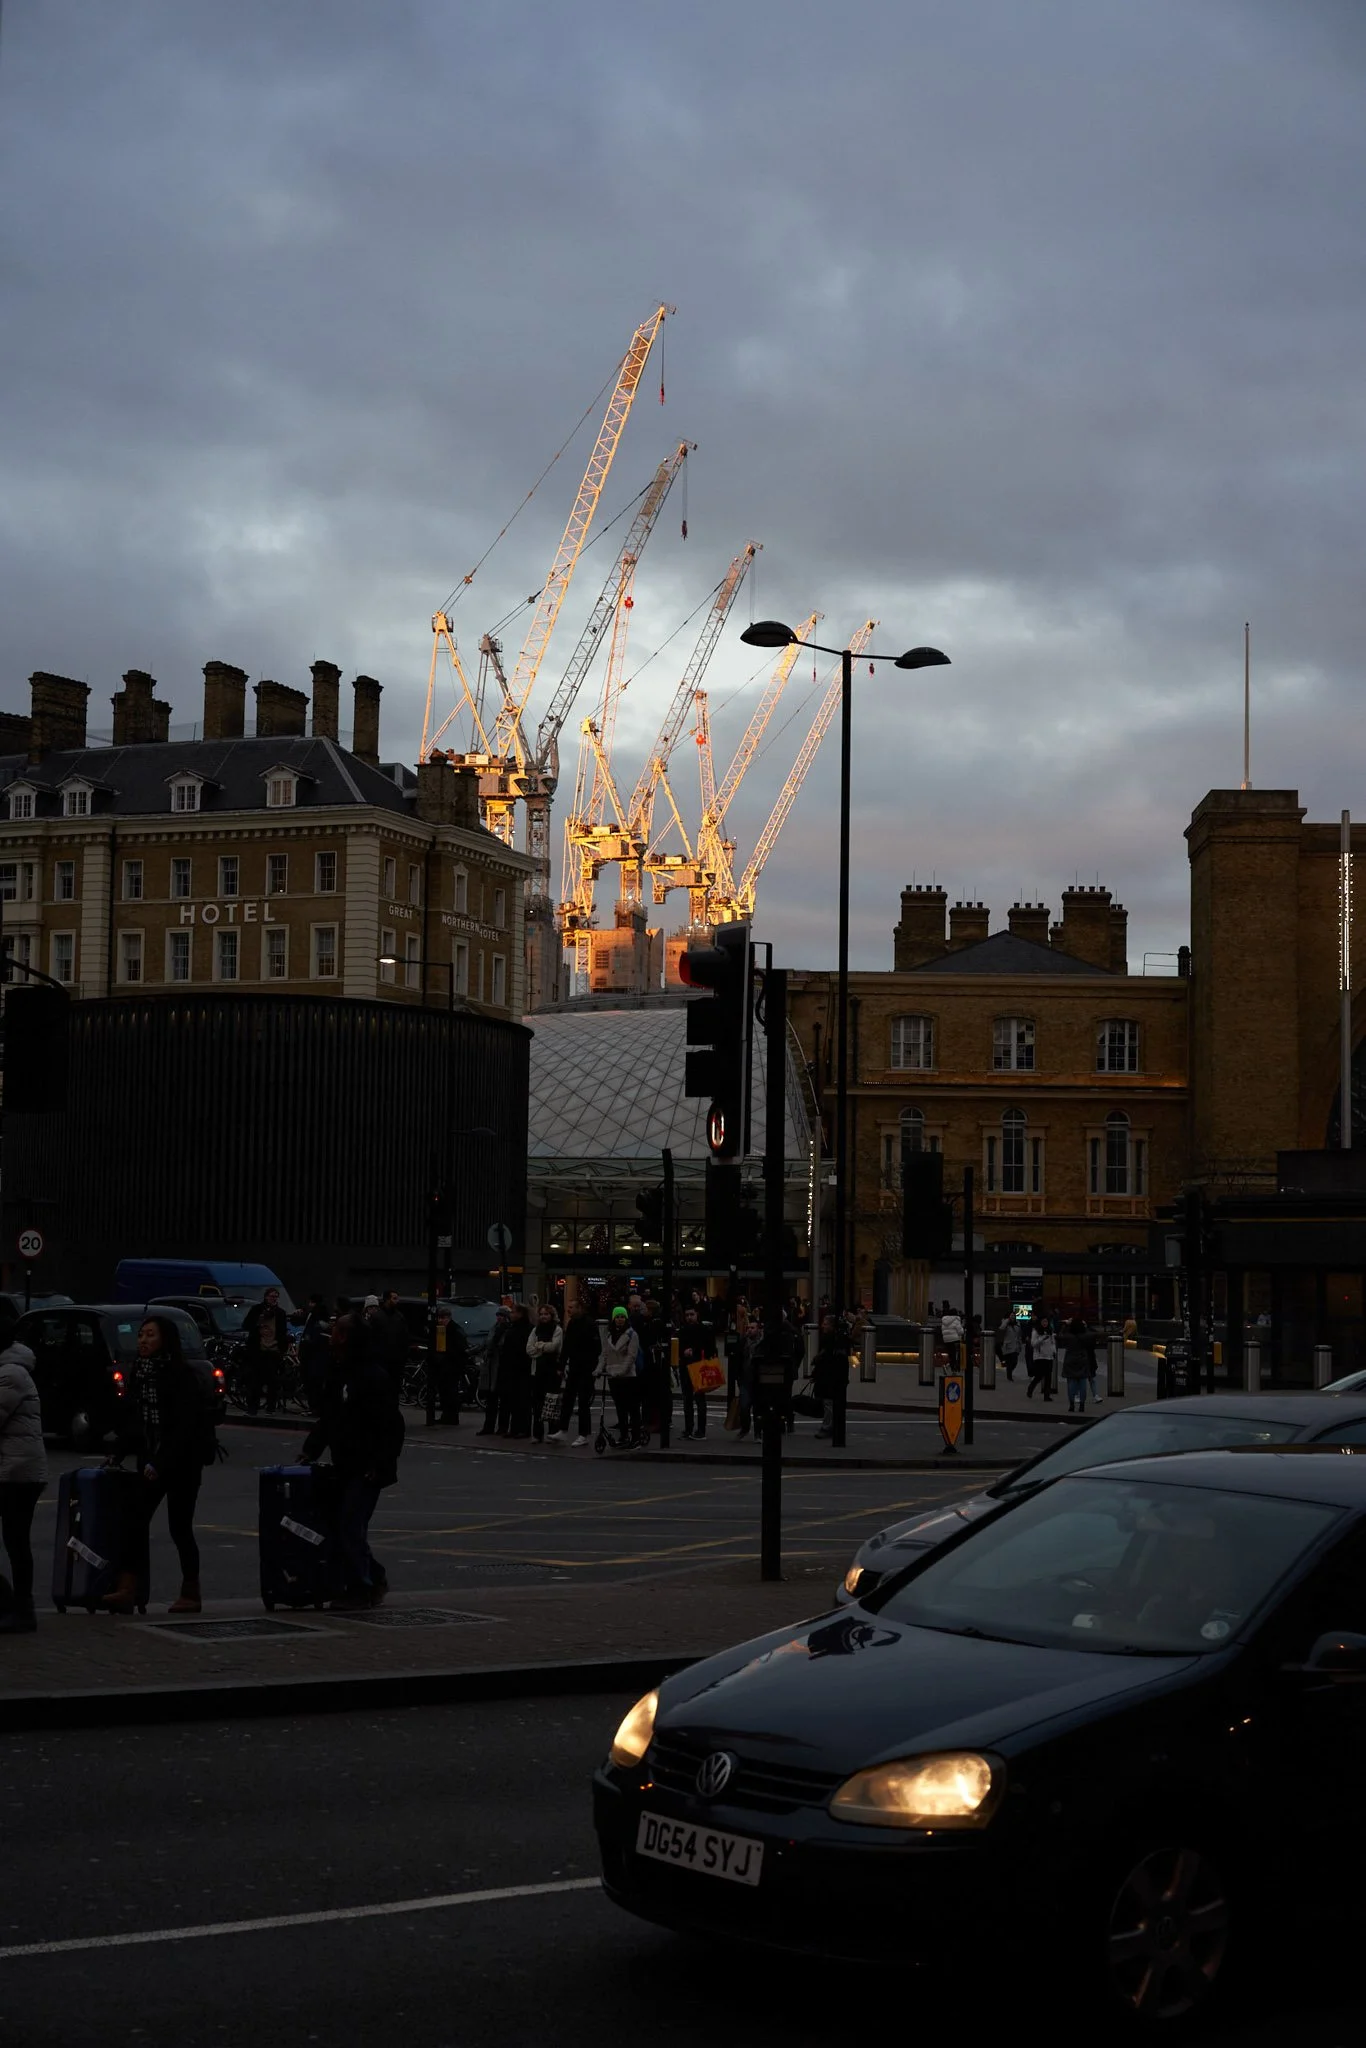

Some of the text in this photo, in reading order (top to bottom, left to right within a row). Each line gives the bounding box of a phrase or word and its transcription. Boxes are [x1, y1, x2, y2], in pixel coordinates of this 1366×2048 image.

[180, 902, 275, 924] HOTEL
[389, 905, 413, 920] GREAT
[442, 914, 480, 933] NORTHERN
[21, 1236, 41, 1250] 20
[679, 1259, 700, 1268] Cross
[644, 1819, 752, 1877] DG54 SYJ
